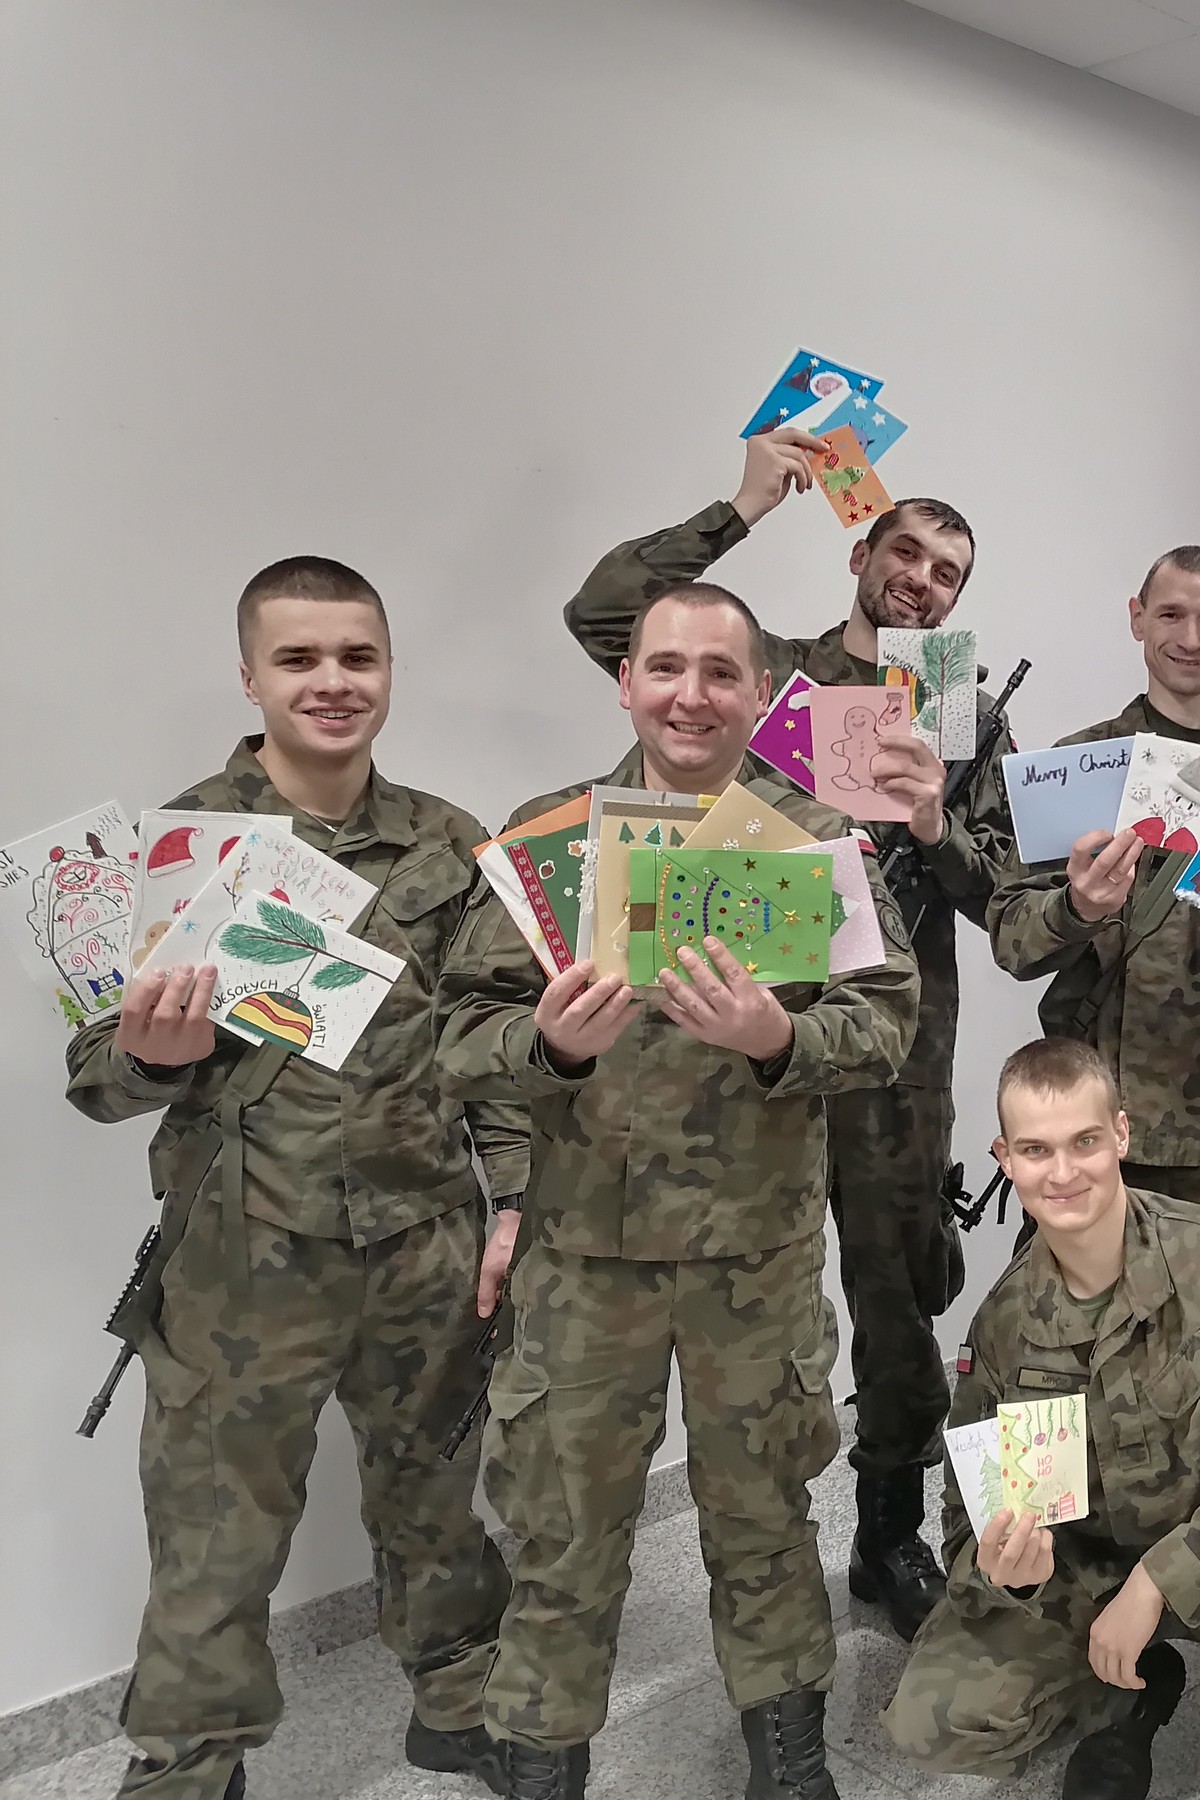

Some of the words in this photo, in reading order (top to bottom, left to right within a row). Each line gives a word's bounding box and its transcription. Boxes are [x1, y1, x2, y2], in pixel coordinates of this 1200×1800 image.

[1021, 764, 1067, 786] Merry
[209, 979, 278, 1012] WESOŁYCH
[1037, 1454, 1053, 1468] HO
[1037, 1465, 1052, 1478] HO
